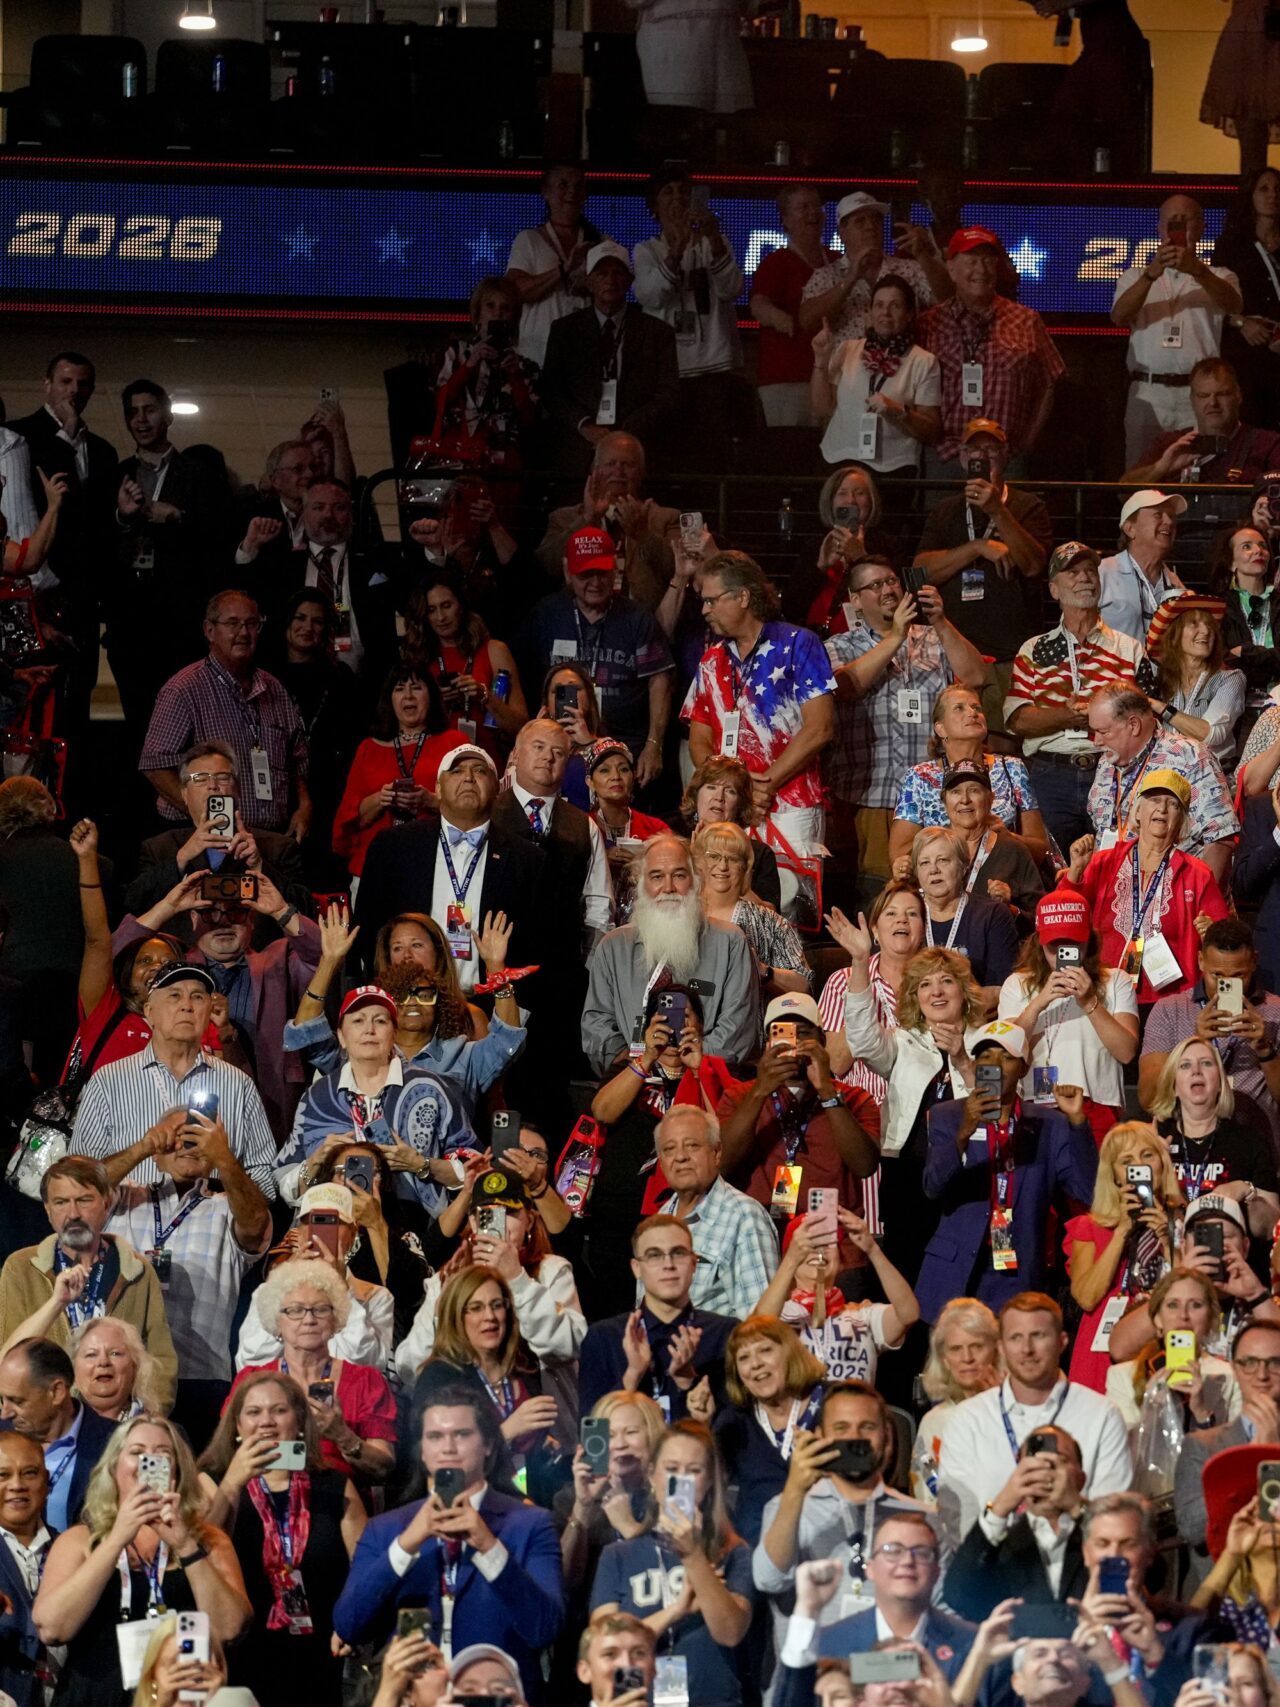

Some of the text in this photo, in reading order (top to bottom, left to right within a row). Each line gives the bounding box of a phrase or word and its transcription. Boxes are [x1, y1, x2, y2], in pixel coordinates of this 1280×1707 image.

[8, 211, 223, 261] 2026
[575, 536, 603, 545] RELAX
[1041, 902, 1086, 914] MAKE AMERICA
[1044, 913, 1083, 925] GREAT AGAIN
[356, 985, 387, 998] USA
